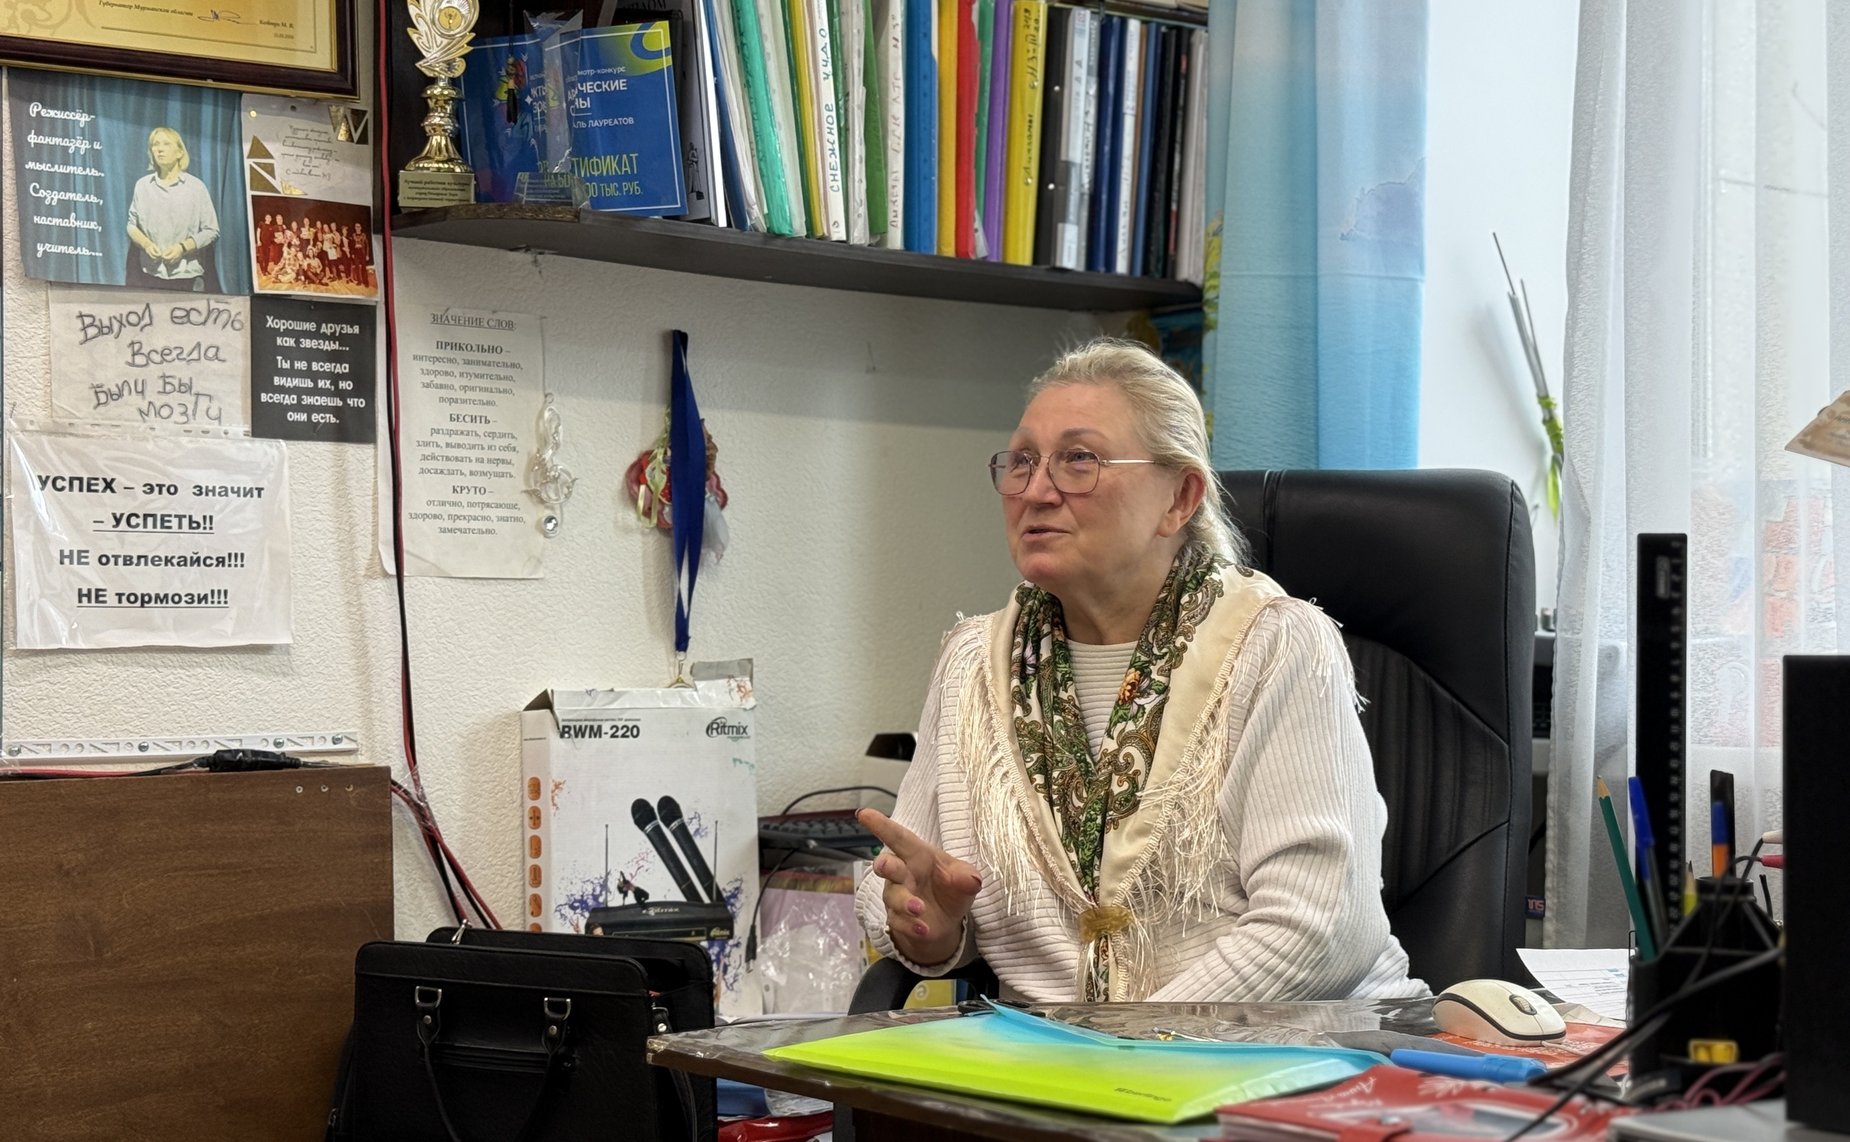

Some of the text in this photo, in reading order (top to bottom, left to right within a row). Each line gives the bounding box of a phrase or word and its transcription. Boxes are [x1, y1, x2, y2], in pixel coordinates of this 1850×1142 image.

[578, 79, 628, 93] ЧЕСКИЕ
[29, 102, 96, 128] Режиссёр-
[588, 117, 634, 128] ЛАУРЕАТОВ
[27, 130, 103, 155] фантазёр и
[824, 103, 840, 193] СНЕЖНОЕ
[25, 161, 105, 177] мыслитель.
[571, 153, 639, 178] ТИФИКАТ
[29, 182, 104, 206] Создатель,
[600, 182, 621, 197] ТЫС.
[623, 181, 643, 196] РУБ.
[33, 212, 102, 232] наставник,
[36, 243, 103, 258] учитель...
[76, 298, 244, 345] Выход есть
[266, 315, 360, 336] Хорошие друзья
[430, 313, 485, 327] ЗНАЧЕНИЕ
[277, 336, 349, 351] как звезды...
[436, 340, 503, 355] ПРИКОЛЬНО
[125, 340, 227, 368] Всегда
[412, 354, 523, 370] интересно, занимательно,
[276, 356, 350, 374] Ты не всегда
[420, 367, 516, 383] здорово, изумительно,
[157, 373, 193, 396] Бы
[273, 376, 353, 391] видишь их, но
[420, 380, 516, 396] забавно, оригинально,
[261, 393, 366, 408] всегда знаешь что
[438, 395, 498, 407] поразительно.
[287, 411, 340, 424] они есть.
[449, 413, 491, 425] БЕСИТЬ
[430, 427, 518, 440] раздражать, сердить,
[416, 440, 443, 449] злить,
[445, 441, 486, 451] выводить
[498, 442, 519, 453] себя,
[419, 453, 473, 463] действовать
[487, 457, 515, 467] нервы,
[418, 466, 467, 477] досаждать,
[37, 475, 117, 494] УСПЕХ
[142, 482, 178, 496] это
[192, 485, 264, 499] значит
[452, 485, 487, 495] КРУТО
[426, 499, 465, 509] отлично,
[111, 512, 214, 530] УСПЕТЬ!!
[408, 512, 445, 522] здорово,
[447, 513, 494, 523] прекрасно,
[438, 526, 498, 536] замечательно.
[59, 549, 245, 568] НЕ отвлекайся!!!
[77, 588, 229, 608] НЕ тормози!!!
[706, 717, 749, 739] Ritmix
